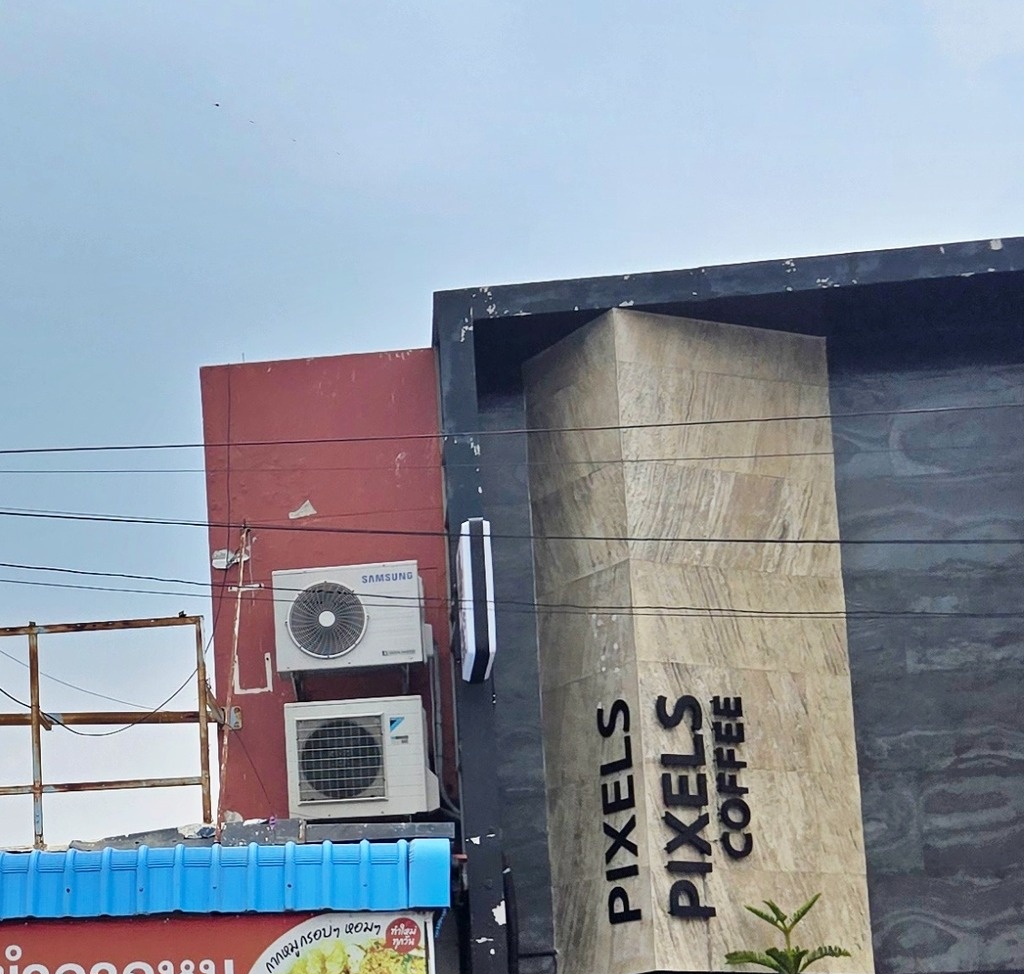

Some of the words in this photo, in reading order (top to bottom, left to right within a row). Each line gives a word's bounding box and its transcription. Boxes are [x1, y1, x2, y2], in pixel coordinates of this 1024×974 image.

[361, 571, 414, 584] SAMSUNG
[596, 699, 642, 925] PIXELS
[656, 695, 716, 918] PIXELS
[711, 695, 753, 860] COFFEE
